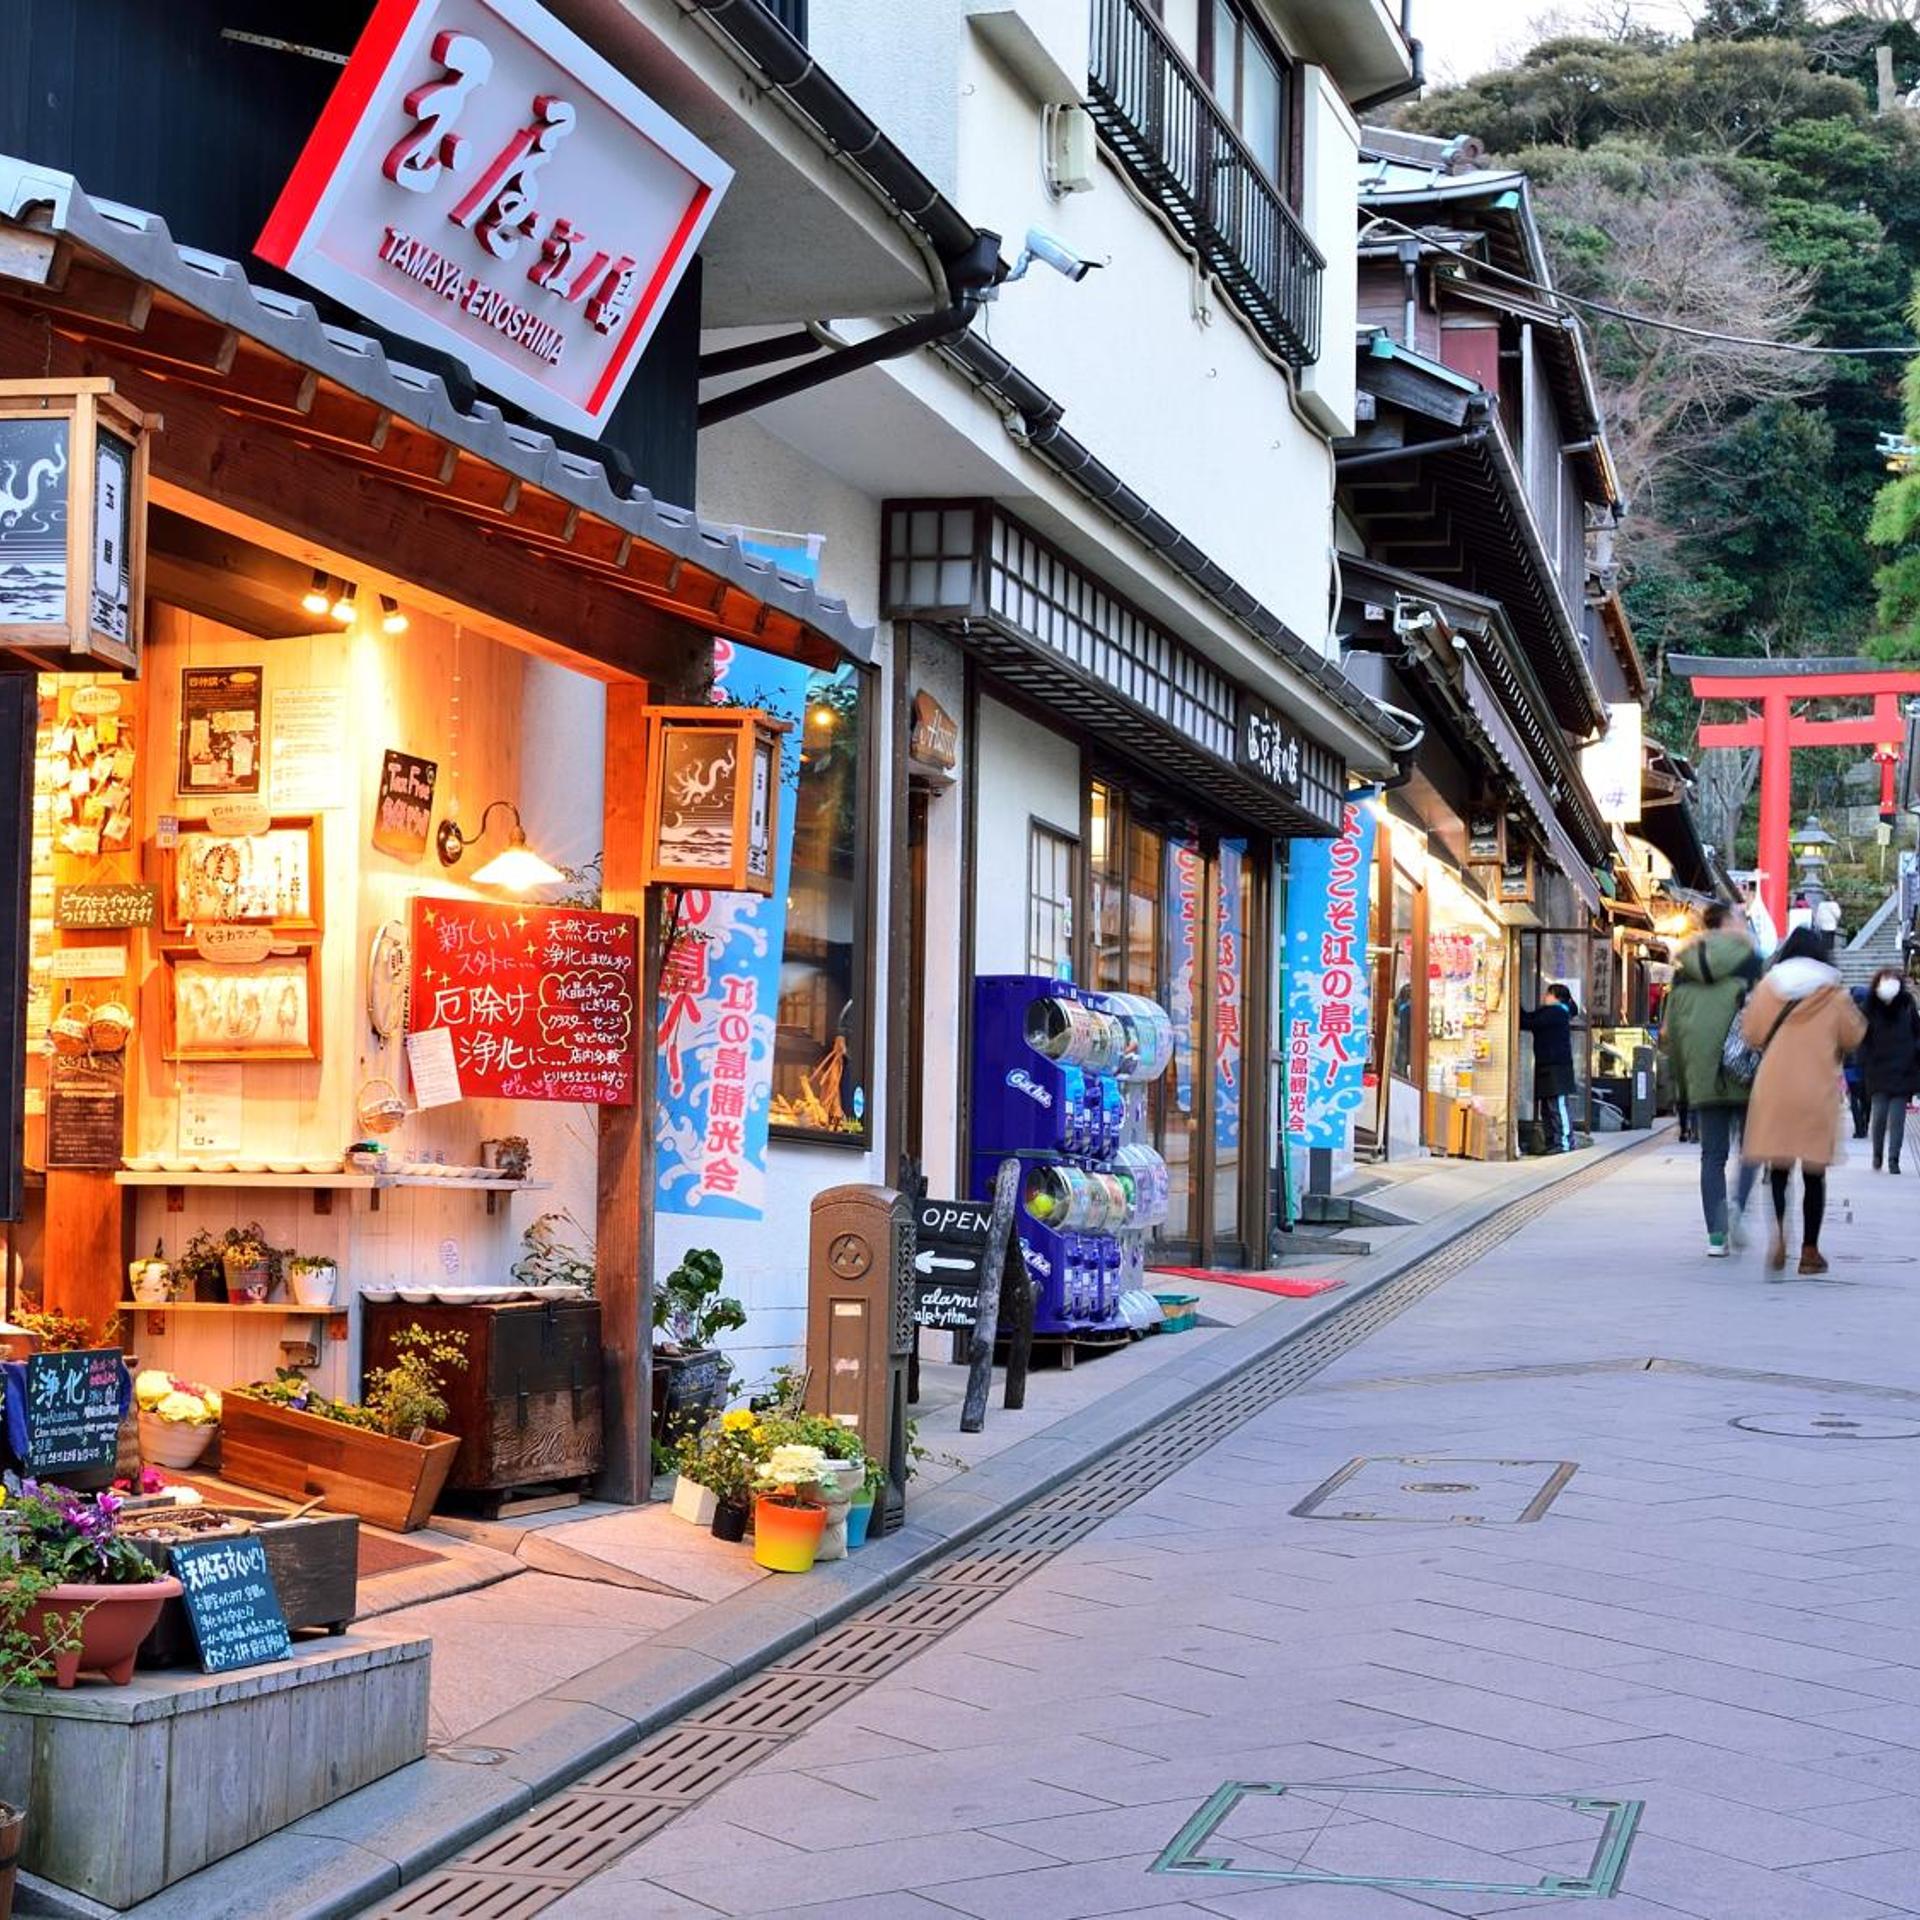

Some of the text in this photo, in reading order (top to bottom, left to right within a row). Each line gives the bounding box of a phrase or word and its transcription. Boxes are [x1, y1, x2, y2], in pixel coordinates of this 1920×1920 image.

[436, 916, 510, 954] 新しい
[546, 919, 616, 945] 天然石で
[556, 981, 615, 1003] 水晶チップ
[429, 982, 534, 1029] 厄除け
[580, 998, 621, 1013] にぎり石
[568, 1049, 622, 1066] 店内多数
[1288, 1020, 1310, 1134] 江の島観光会
[921, 1207, 994, 1233] OPEN
[36, 1367, 86, 1409] 浄化
